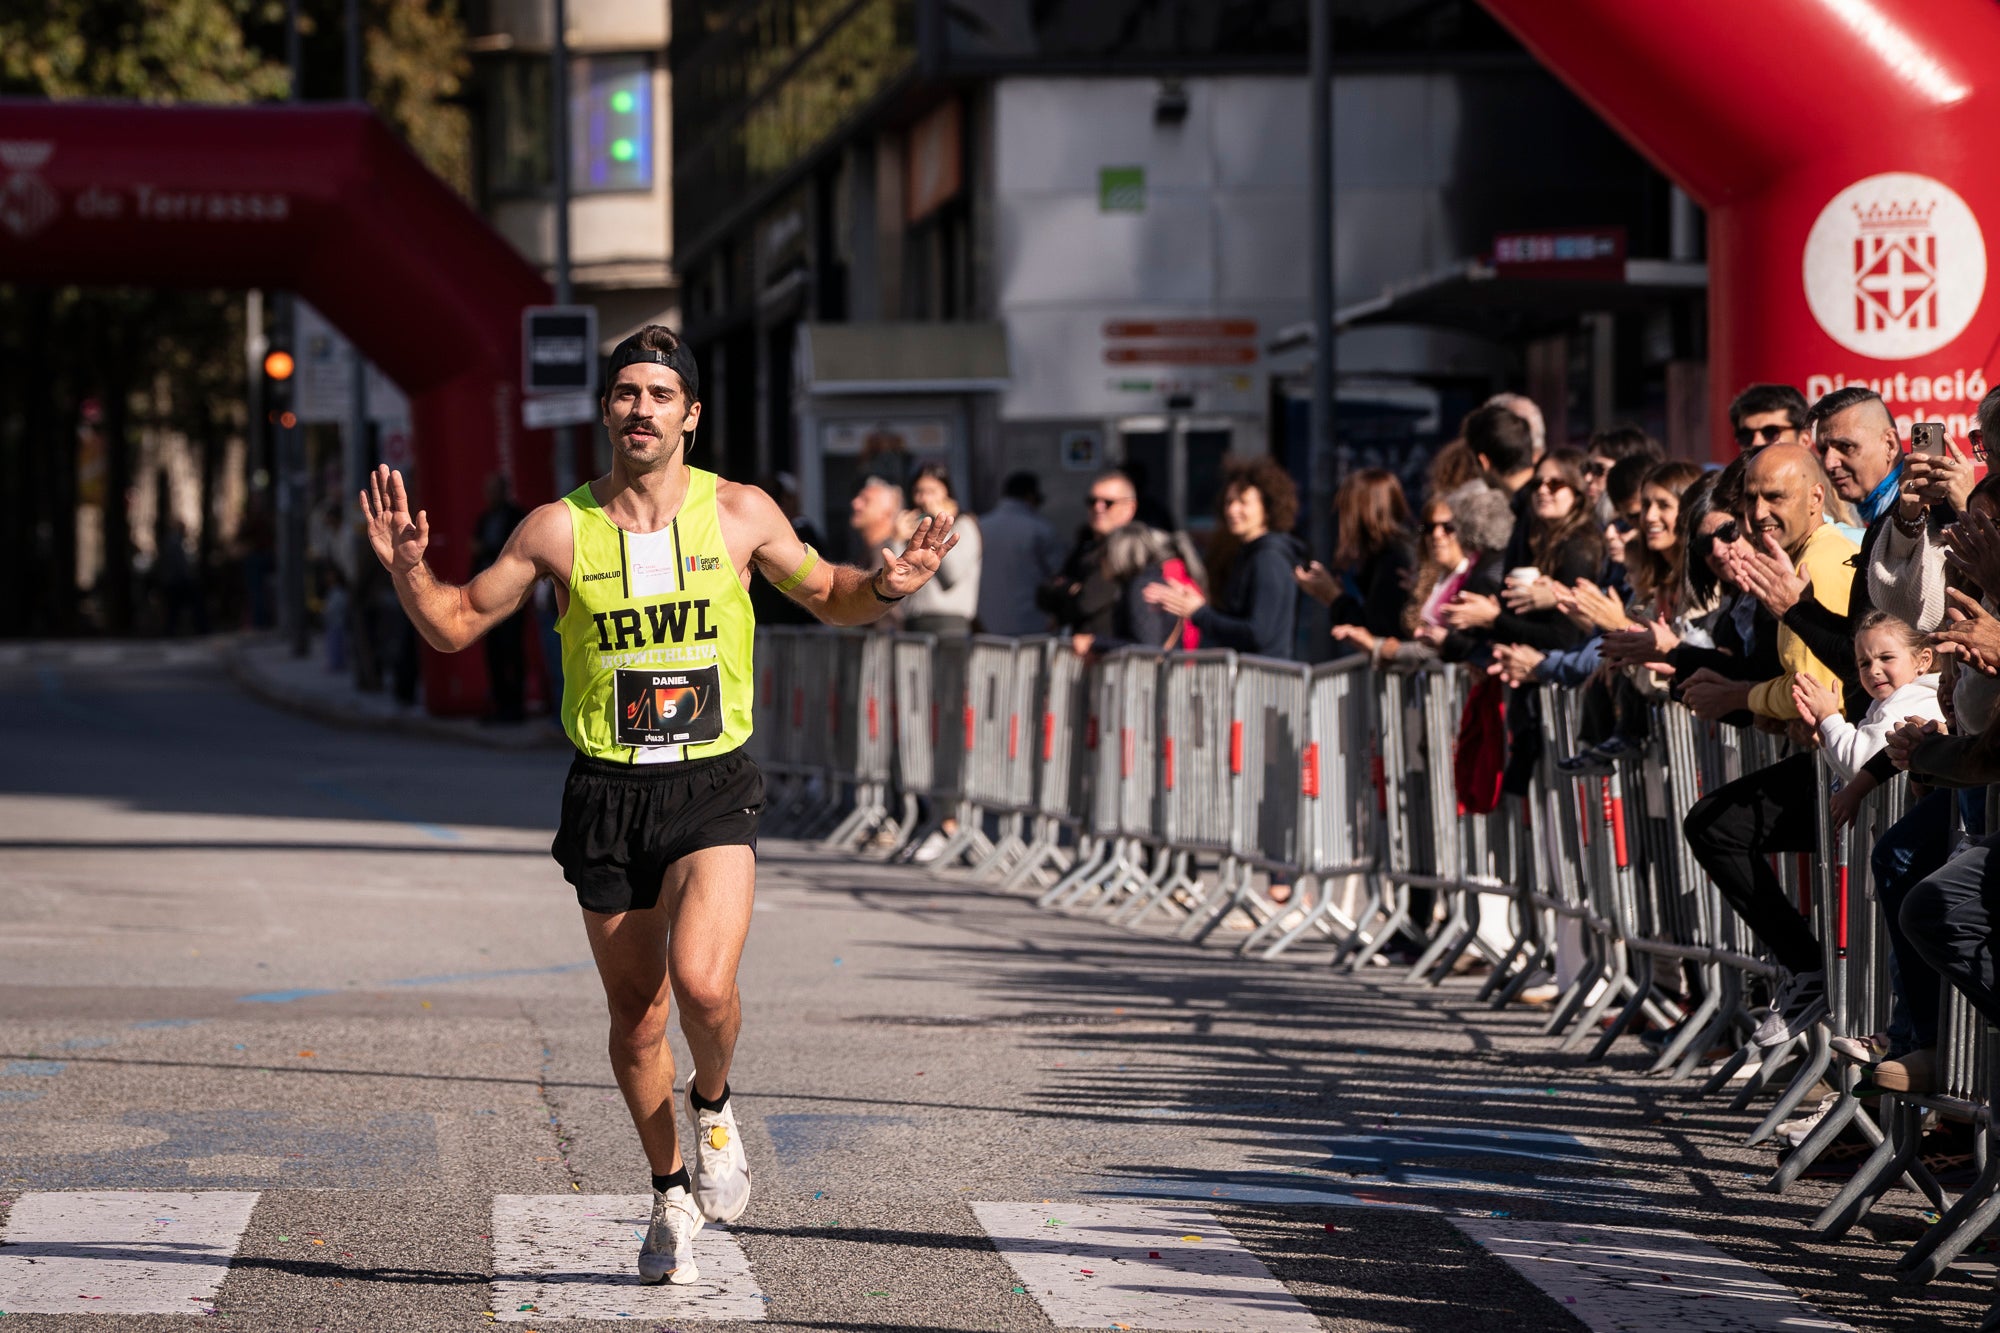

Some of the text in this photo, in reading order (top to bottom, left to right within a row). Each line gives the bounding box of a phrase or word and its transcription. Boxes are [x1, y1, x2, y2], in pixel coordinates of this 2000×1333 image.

[1806, 368, 1987, 408] Diutació
[700, 557, 719, 565] GRUPO
[582, 570, 620, 582] KRONOSALUD
[593, 599, 718, 651] IRWL
[652, 676, 689, 686] DANIEL
[662, 699, 678, 719] 5
